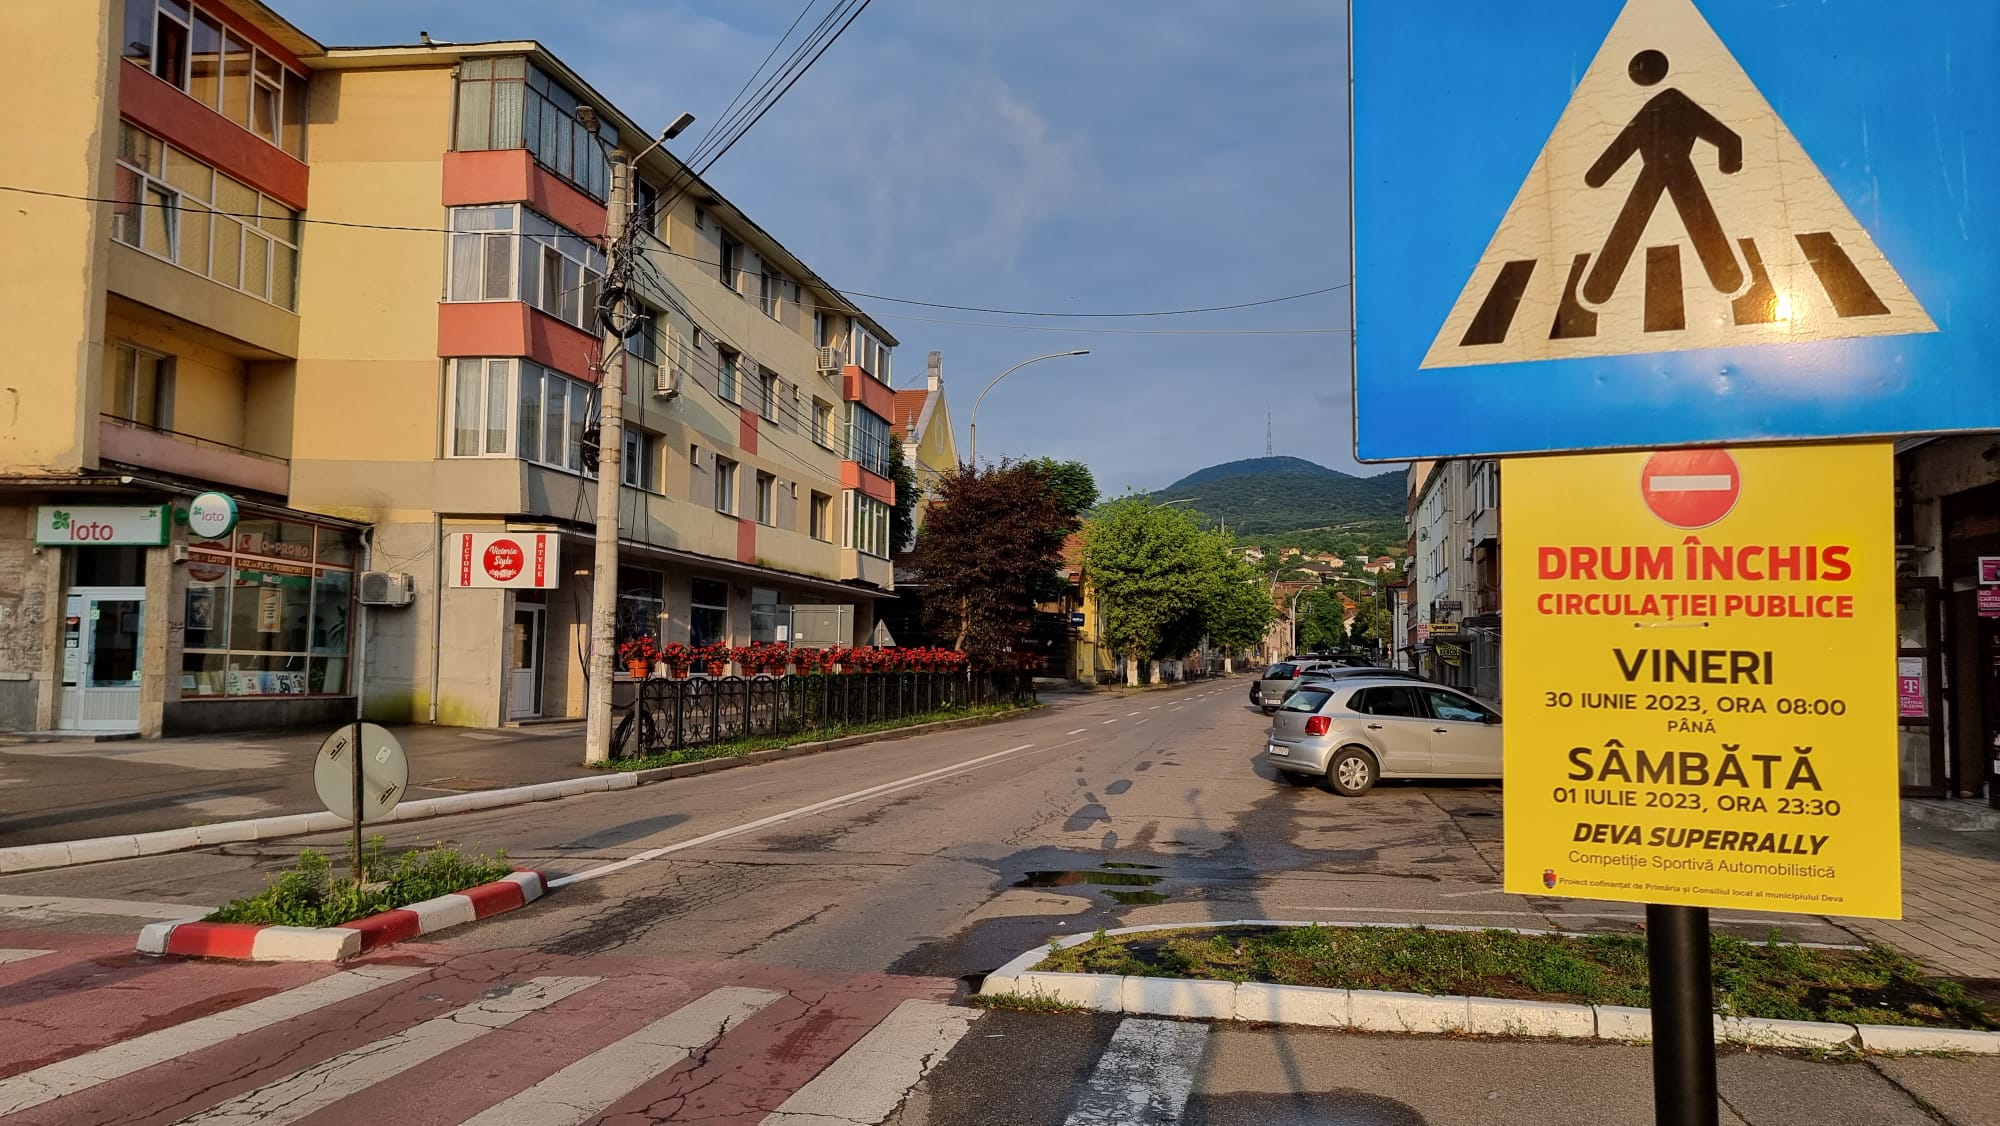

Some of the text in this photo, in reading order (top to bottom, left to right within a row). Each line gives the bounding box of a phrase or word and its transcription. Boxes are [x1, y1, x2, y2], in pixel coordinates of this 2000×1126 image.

[202, 510, 224, 522] loto
[70, 519, 114, 541] loto
[463, 535, 471, 586] VICTORIA
[488, 545, 518, 556] Victoria
[494, 555, 513, 568] Style
[1538, 535, 1852, 581] DRUM ÎNCHIS
[1725, 594, 1854, 618] PUBLICE
[1612, 648, 1774, 686] VINERI
[1544, 691, 1847, 717] 30 IUNIE 2023, ORA 08:00
[1667, 716, 1717, 734] PÂNĂ
[1567, 739, 1823, 791] SÂMBĂTĂ
[1553, 787, 1841, 817] 01 IULIE 2023, ORA 23:30
[1572, 822, 1830, 856] DEVA SUPERRALLY
[1651, 855, 1715, 872] Sportivă
[1717, 859, 1836, 879] Automobilistică
[1559, 877, 1588, 886] Proiect
[1692, 886, 1730, 895] Consiliul
[1732, 888, 1753, 897] local
[1755, 890, 1763, 898] al
[1765, 891, 1819, 902] municipiului
[1821, 894, 1844, 903] Deva
